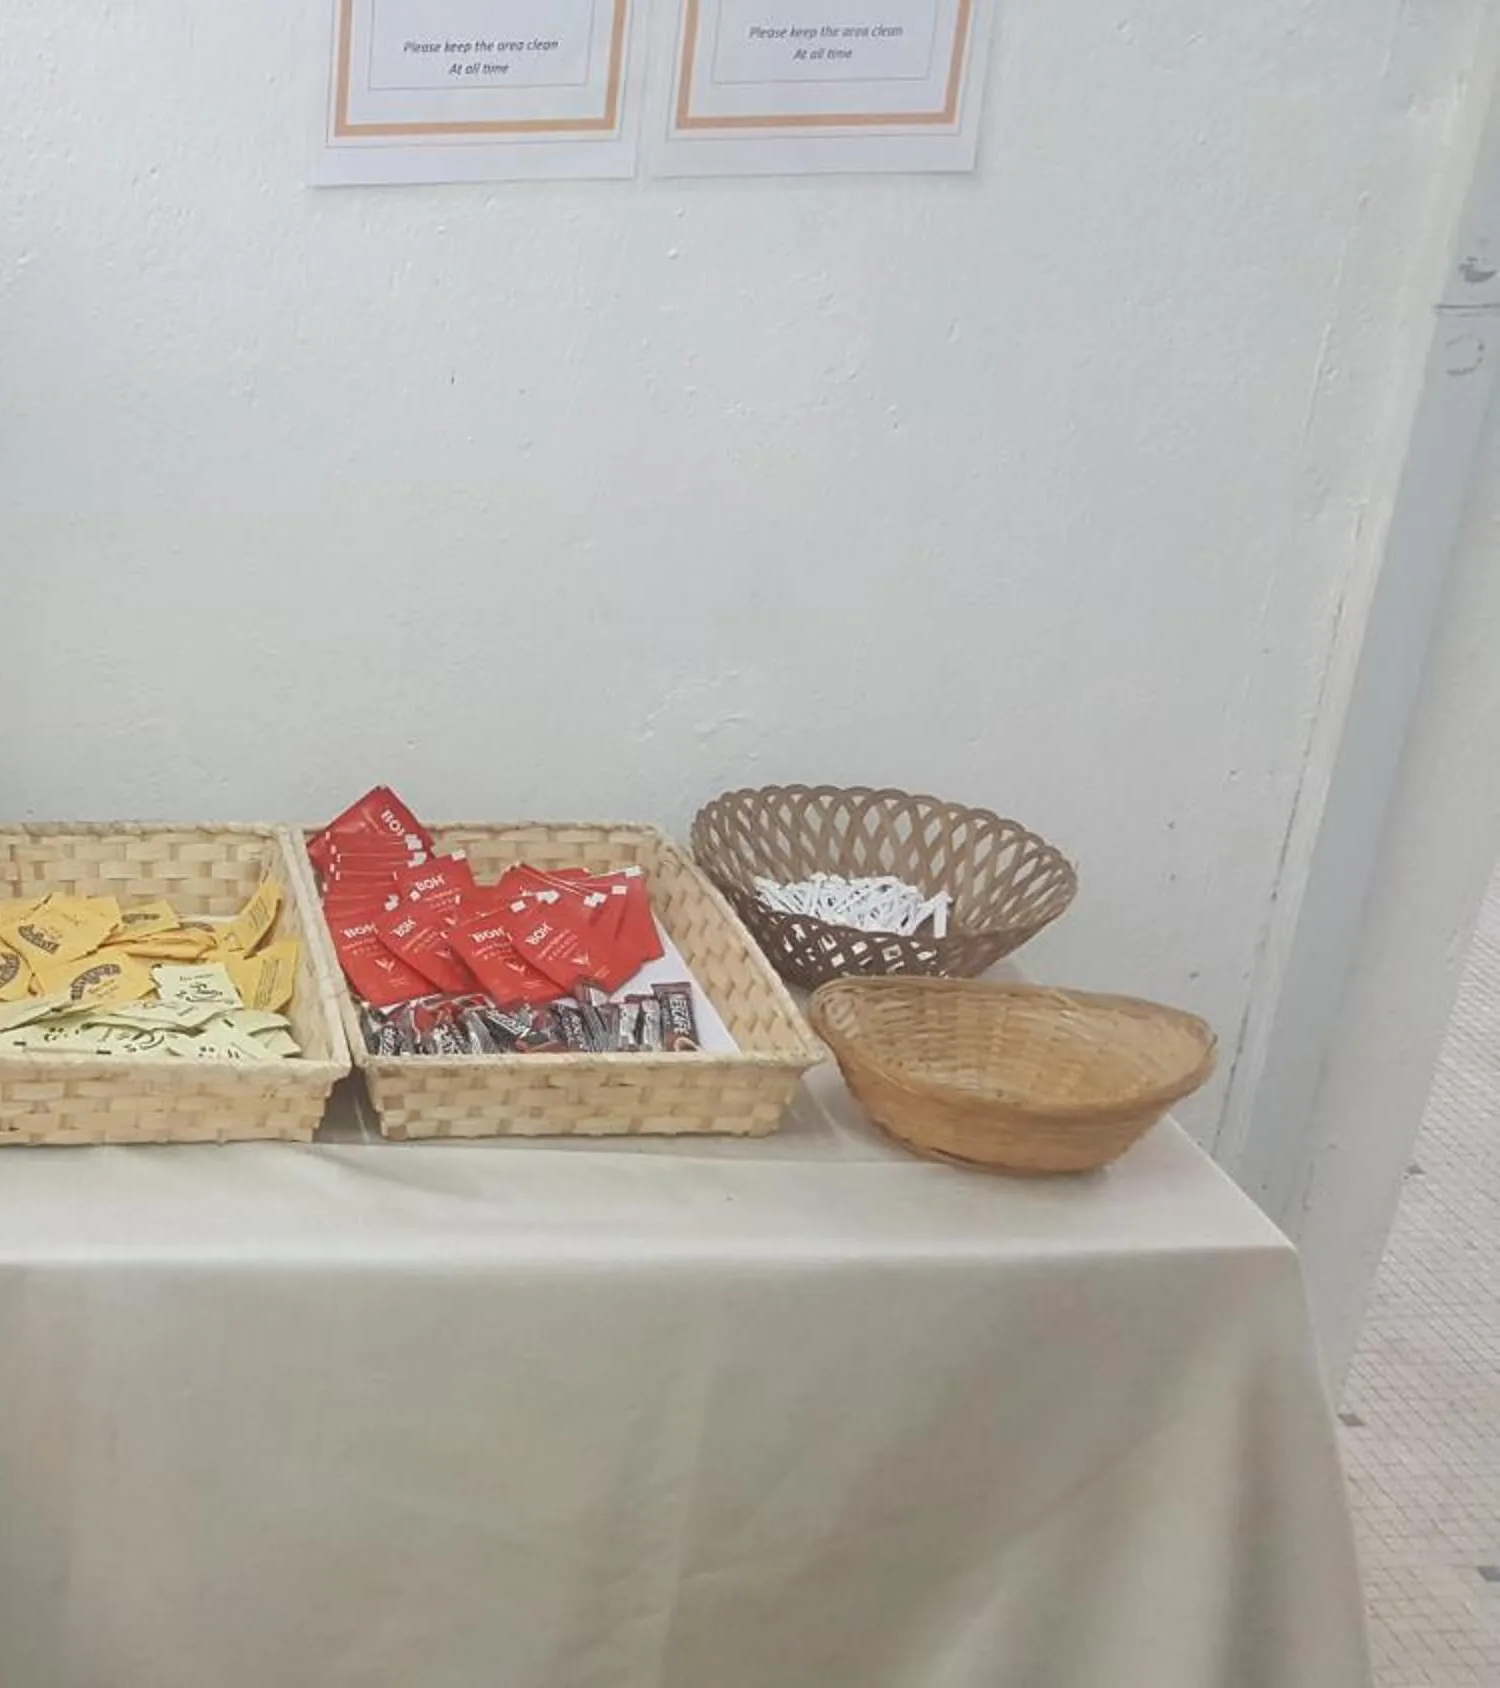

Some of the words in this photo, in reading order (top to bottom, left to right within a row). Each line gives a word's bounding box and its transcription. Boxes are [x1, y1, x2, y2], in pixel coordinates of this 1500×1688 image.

[749, 26, 788, 39] Please
[790, 25, 818, 40] keep
[820, 25, 839, 37] the
[842, 26, 869, 37] area
[871, 25, 903, 37] clean
[403, 41, 441, 53] Please
[444, 40, 472, 54] keep
[475, 40, 495, 52] the
[497, 40, 524, 51] area
[526, 38, 559, 50] clean
[793, 48, 808, 60] At
[810, 47, 825, 59] all
[827, 47, 852, 59] time
[449, 63, 463, 75] At
[465, 62, 480, 74] all
[482, 62, 509, 75] time
[415, 872, 445, 892] BOH
[392, 915, 417, 938] BOH
[524, 920, 553, 945] BOH
